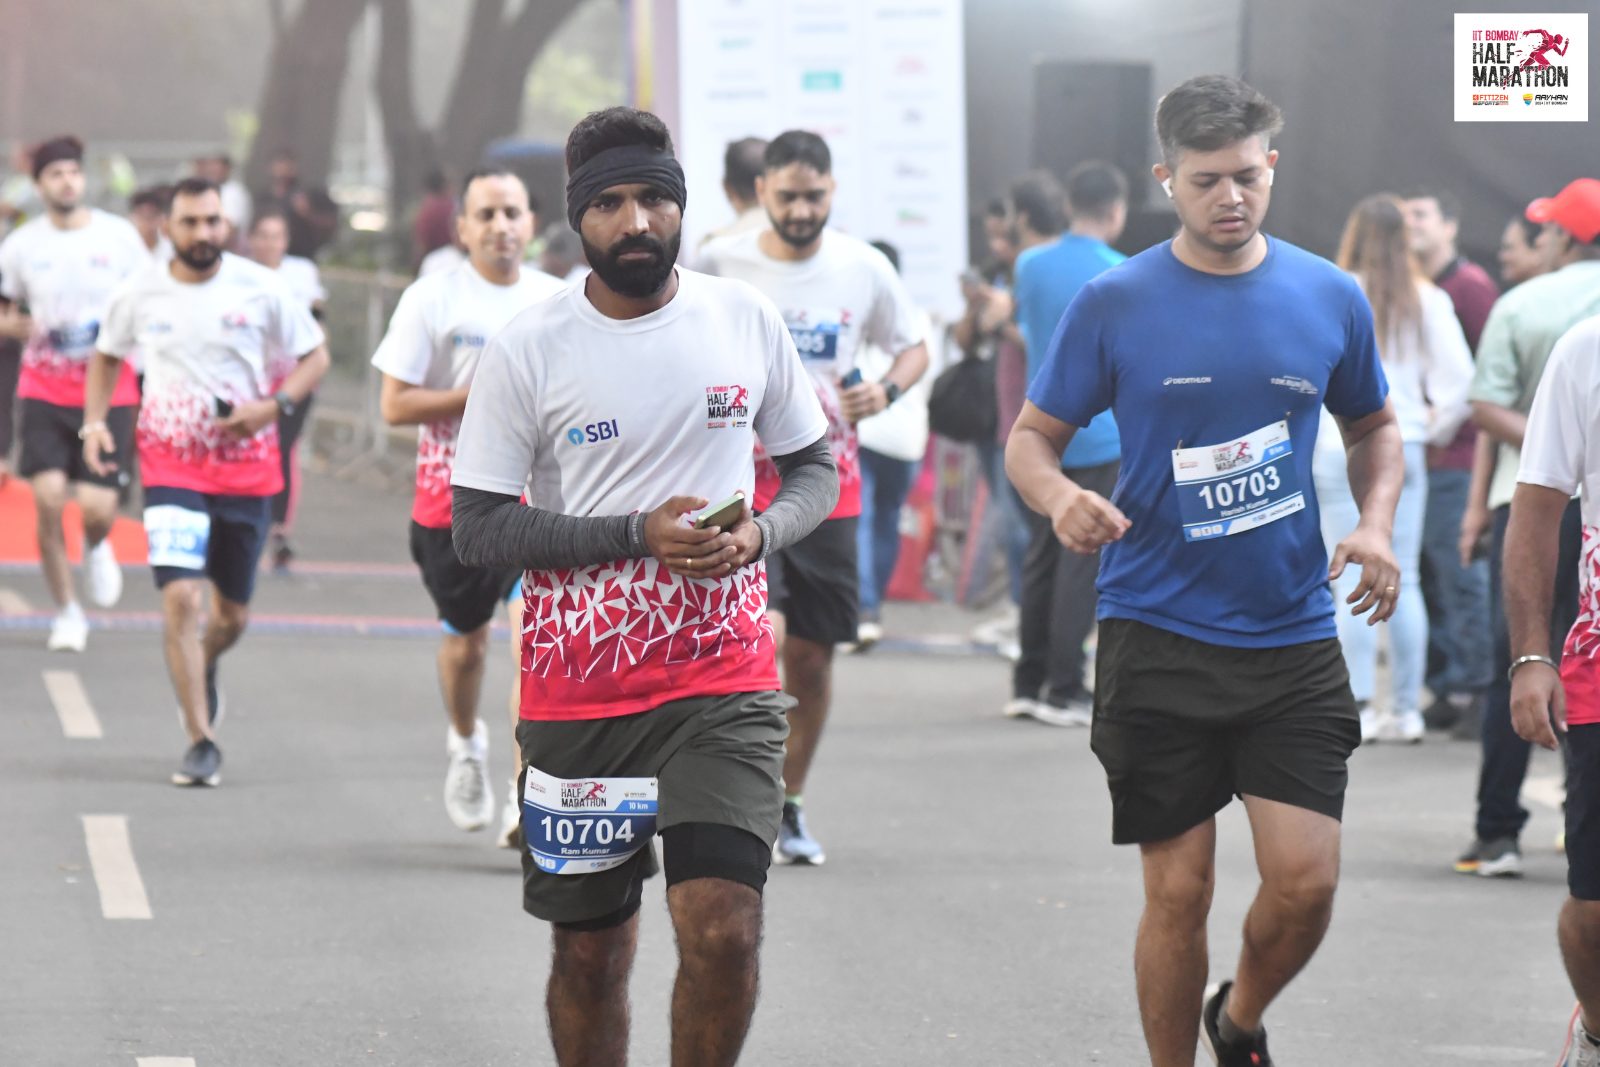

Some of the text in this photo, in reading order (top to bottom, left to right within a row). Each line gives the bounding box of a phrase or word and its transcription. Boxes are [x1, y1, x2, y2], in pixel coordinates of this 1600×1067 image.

[707, 392, 729, 406] HALF
[708, 405, 749, 419] MARATHON
[585, 419, 619, 443] SBI
[1198, 466, 1281, 510] 10703
[561, 788, 582, 798] HALF
[561, 797, 607, 808] MARATHON
[629, 802, 649, 810] 10 km
[541, 815, 635, 845] 10704
[560, 847, 610, 855] Ram Kumar
